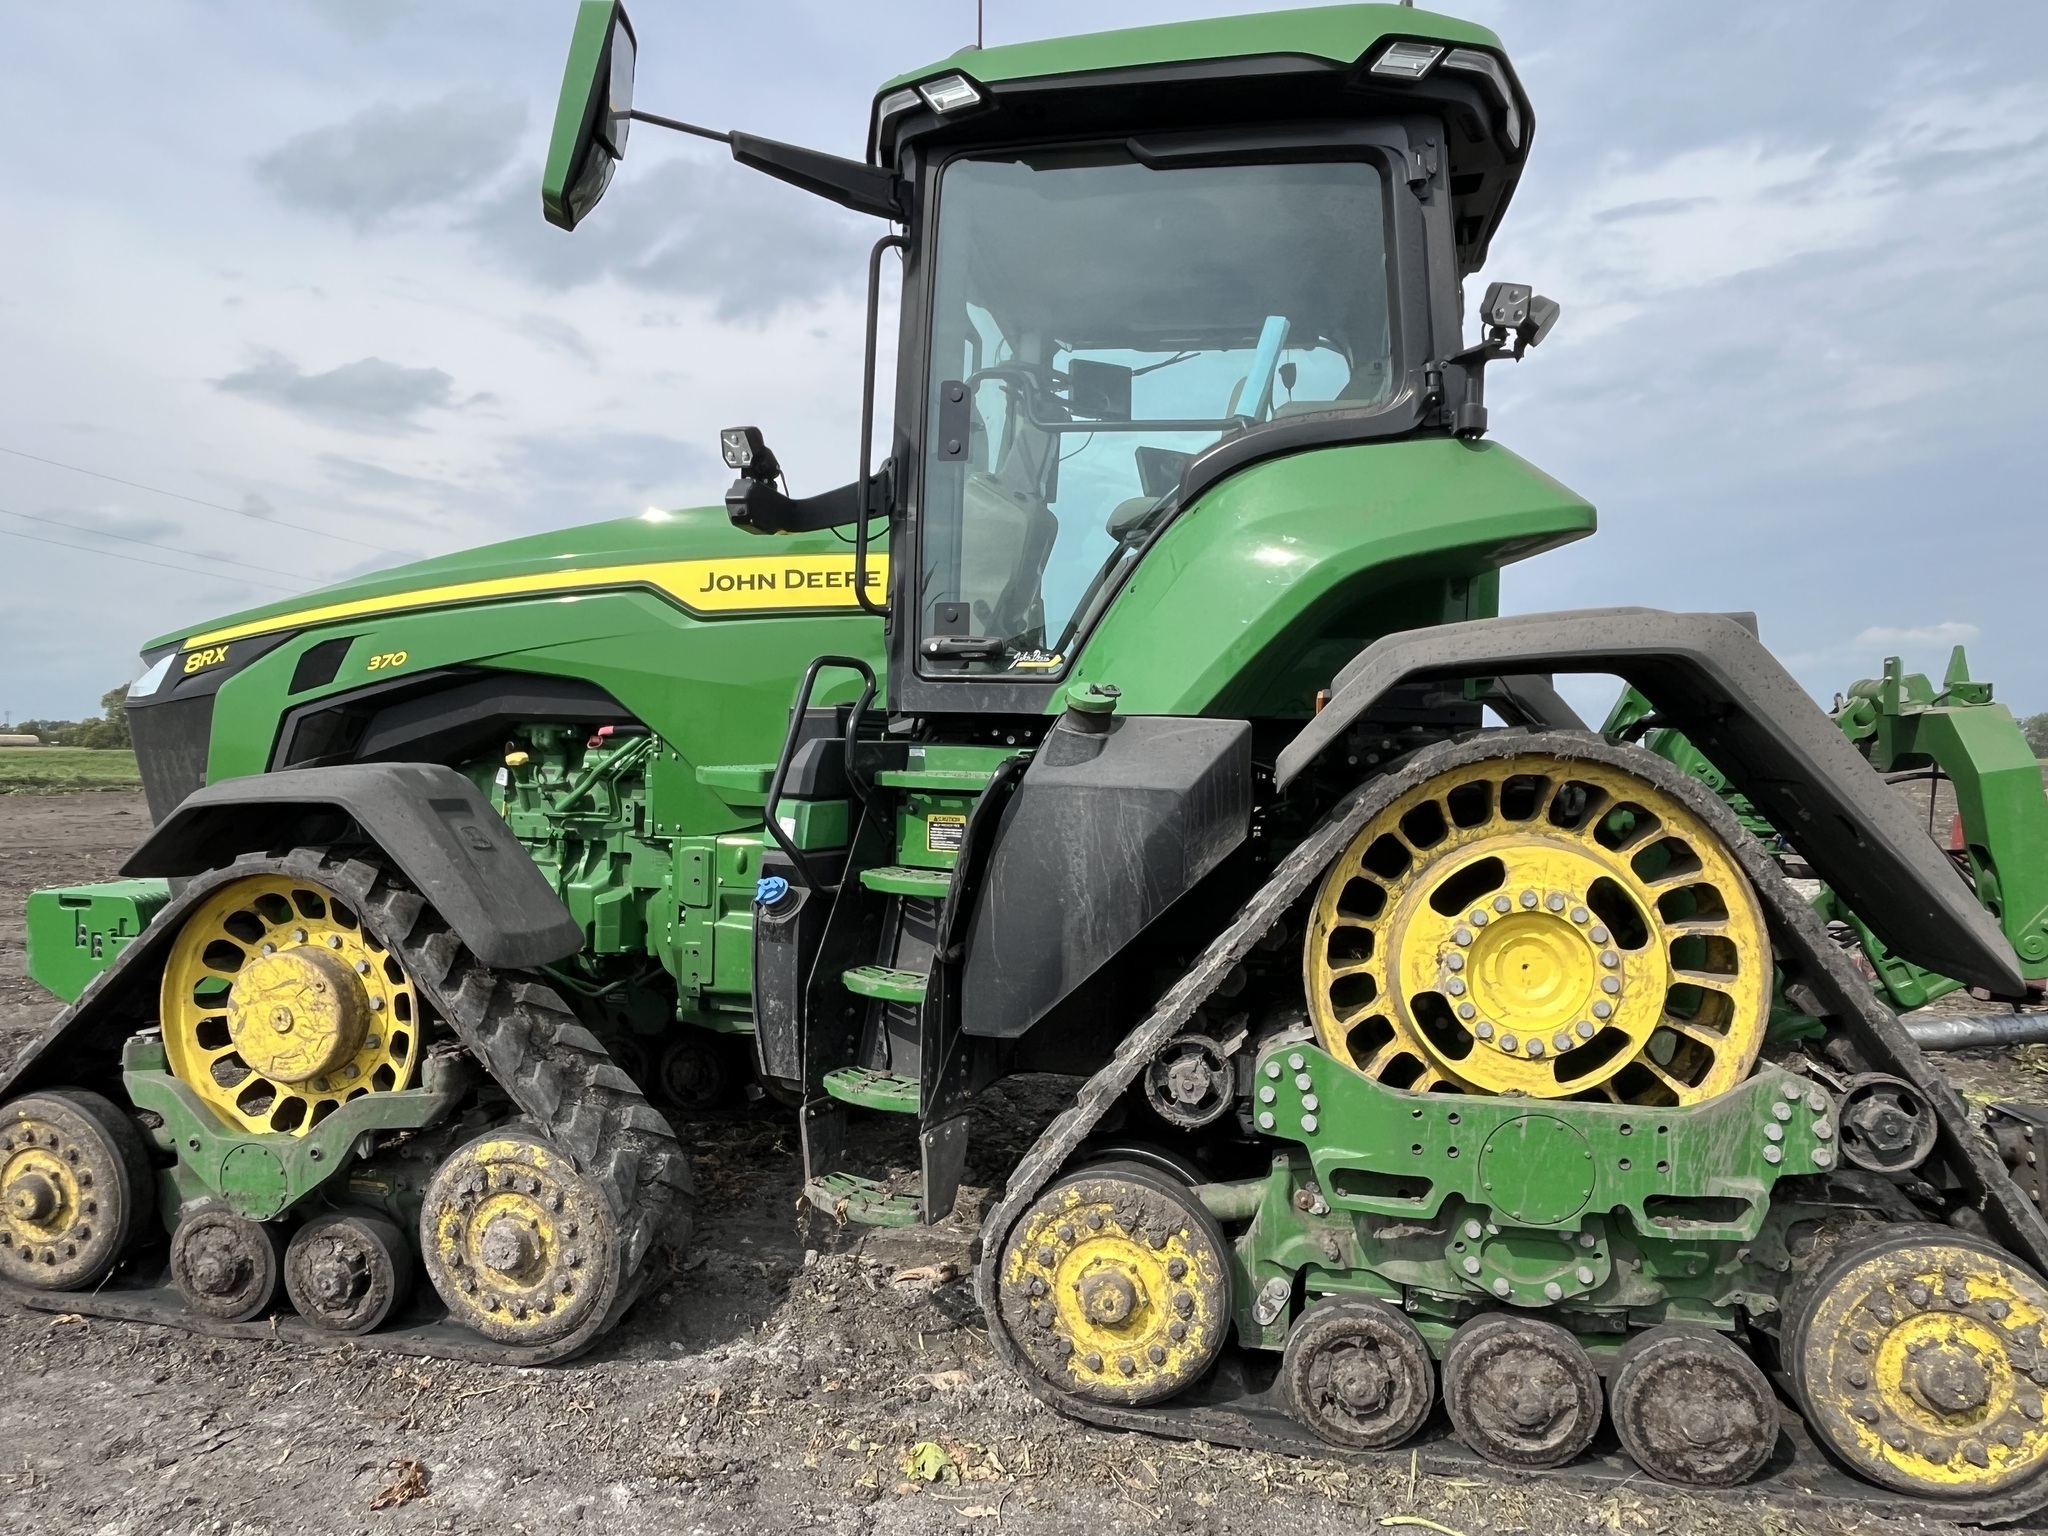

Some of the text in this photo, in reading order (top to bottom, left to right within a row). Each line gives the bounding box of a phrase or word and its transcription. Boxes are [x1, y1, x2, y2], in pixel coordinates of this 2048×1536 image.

[700, 572, 776, 593] JOHN
[183, 645, 230, 673] 8RX
[367, 651, 408, 671] 370
